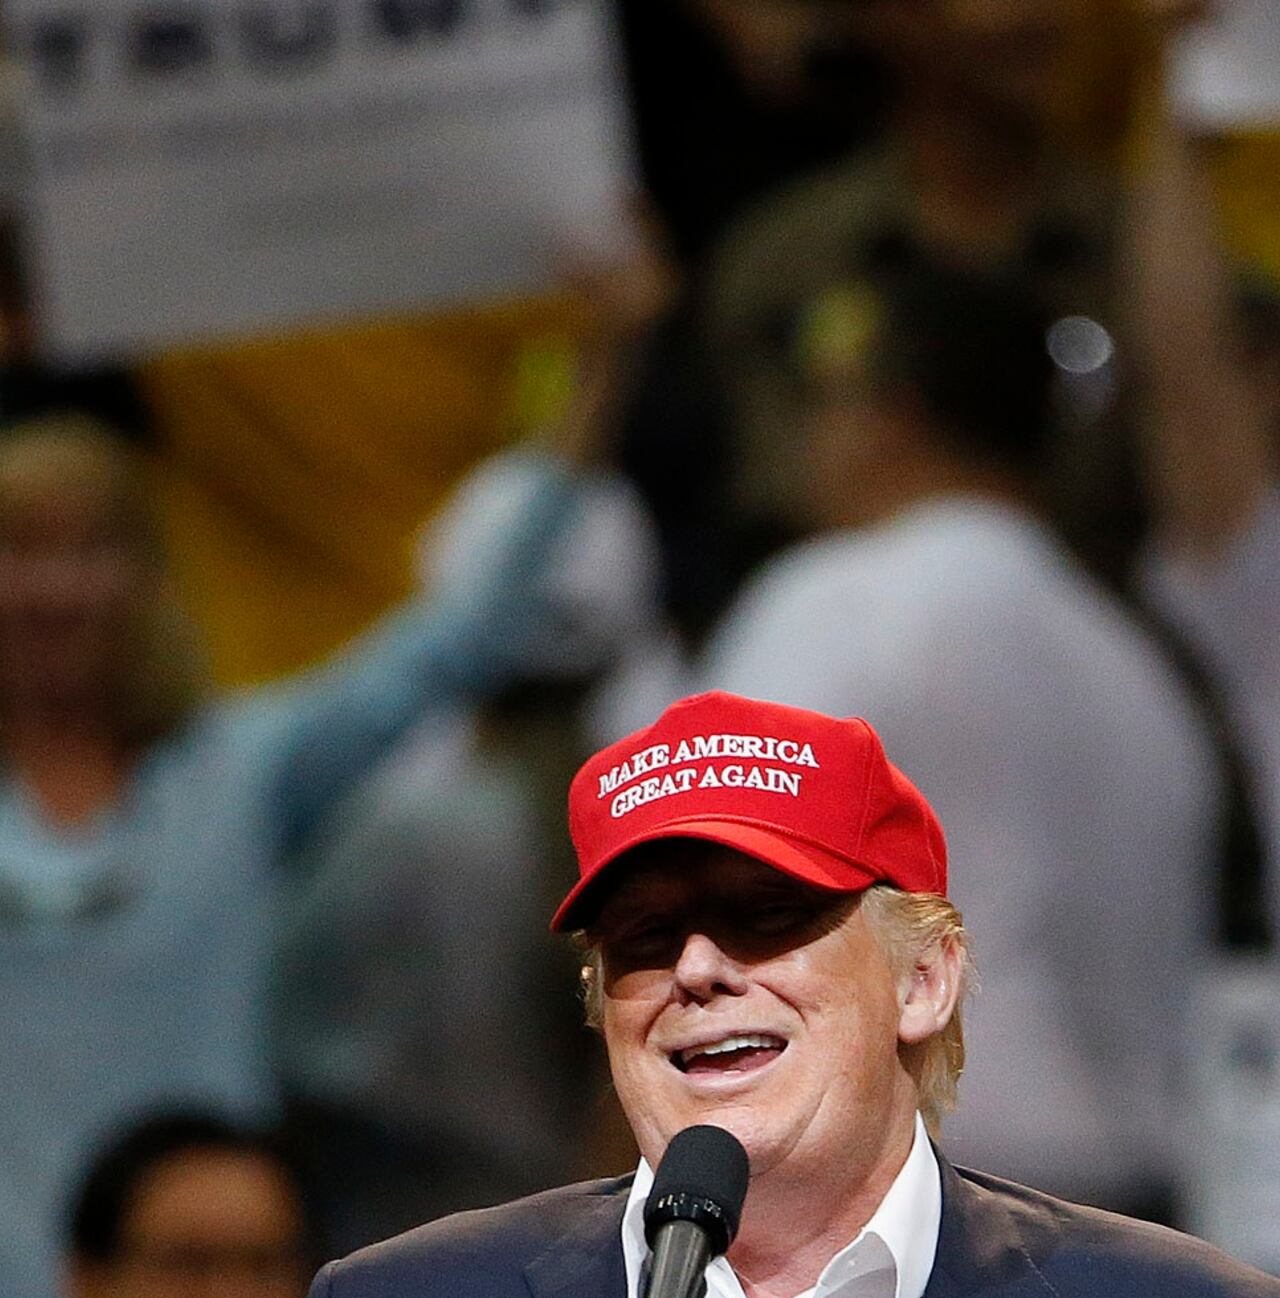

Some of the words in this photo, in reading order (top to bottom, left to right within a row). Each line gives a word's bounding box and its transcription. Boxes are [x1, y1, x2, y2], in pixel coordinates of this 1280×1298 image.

[596, 743, 670, 799] MAKE
[671, 733, 820, 769] AMERICA
[610, 768, 698, 819] GREAT
[697, 765, 802, 797] AGAIN
